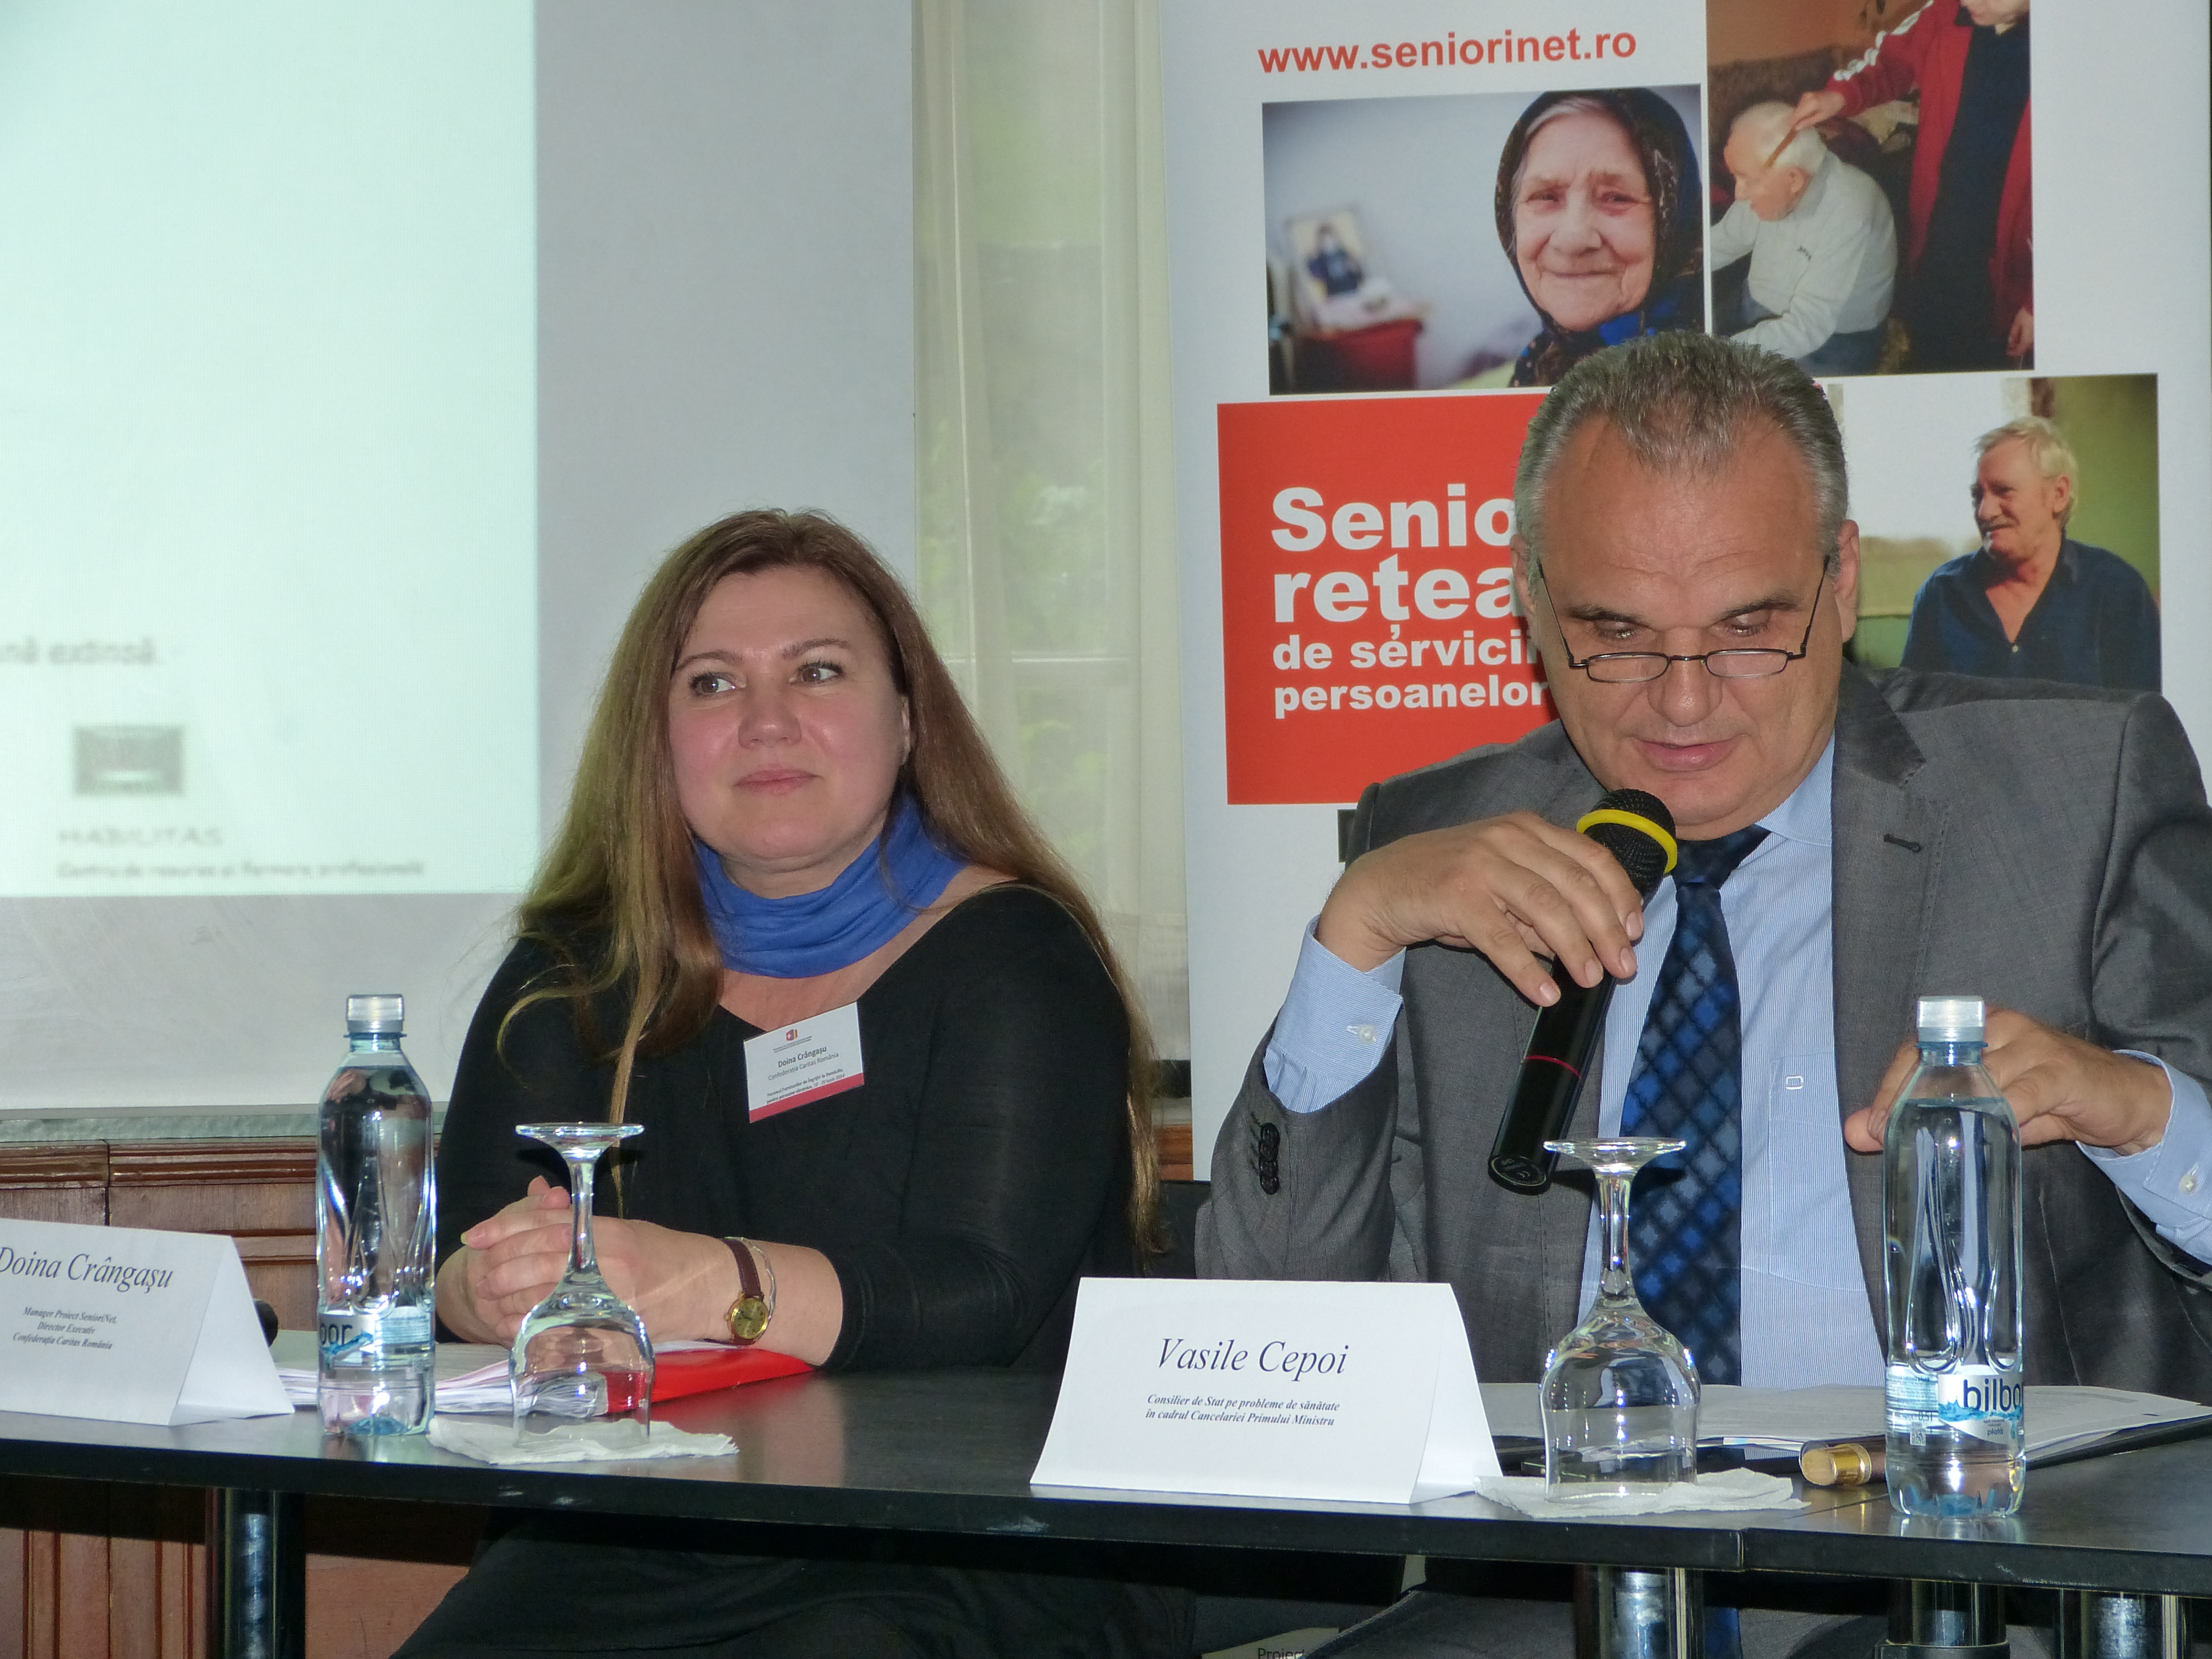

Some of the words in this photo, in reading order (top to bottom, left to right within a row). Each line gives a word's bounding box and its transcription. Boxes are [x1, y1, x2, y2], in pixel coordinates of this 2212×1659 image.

[1258, 27, 1637, 73] www.seniorinet.ro
[1271, 483, 1519, 552] Senio
[1272, 634, 1333, 670] de
[1275, 674, 1549, 719] persoanelor
[778, 1057, 796, 1068] Doina
[799, 1060, 816, 1070] Caritas
[0, 1246, 62, 1279] Doina
[23, 1307, 54, 1319] Manager
[37, 1321, 66, 1332] Director
[66, 1324, 96, 1335] Executiv
[56, 1336, 81, 1347] Caritas
[81, 1338, 113, 1350] România
[1159, 1338, 1249, 1371] Vasile
[1259, 1340, 1350, 1382] Cepoi
[1147, 1394, 1191, 1406] Consilier
[1191, 1396, 1203, 1406] de
[1204, 1396, 1225, 1407] Stat
[1224, 1399, 1238, 1410] pe
[1238, 1398, 1284, 1410] probleme
[1286, 1400, 1298, 1410] de
[1300, 1401, 1340, 1411] sănătate
[1963, 1378, 2024, 1412] bilbo
[1145, 1408, 1156, 1418] în
[1157, 1410, 1190, 1420] cadrul
[1190, 1411, 1246, 1422] Cancelariei
[1246, 1413, 1291, 1424] Primului
[1292, 1414, 1335, 1426] Ministru
